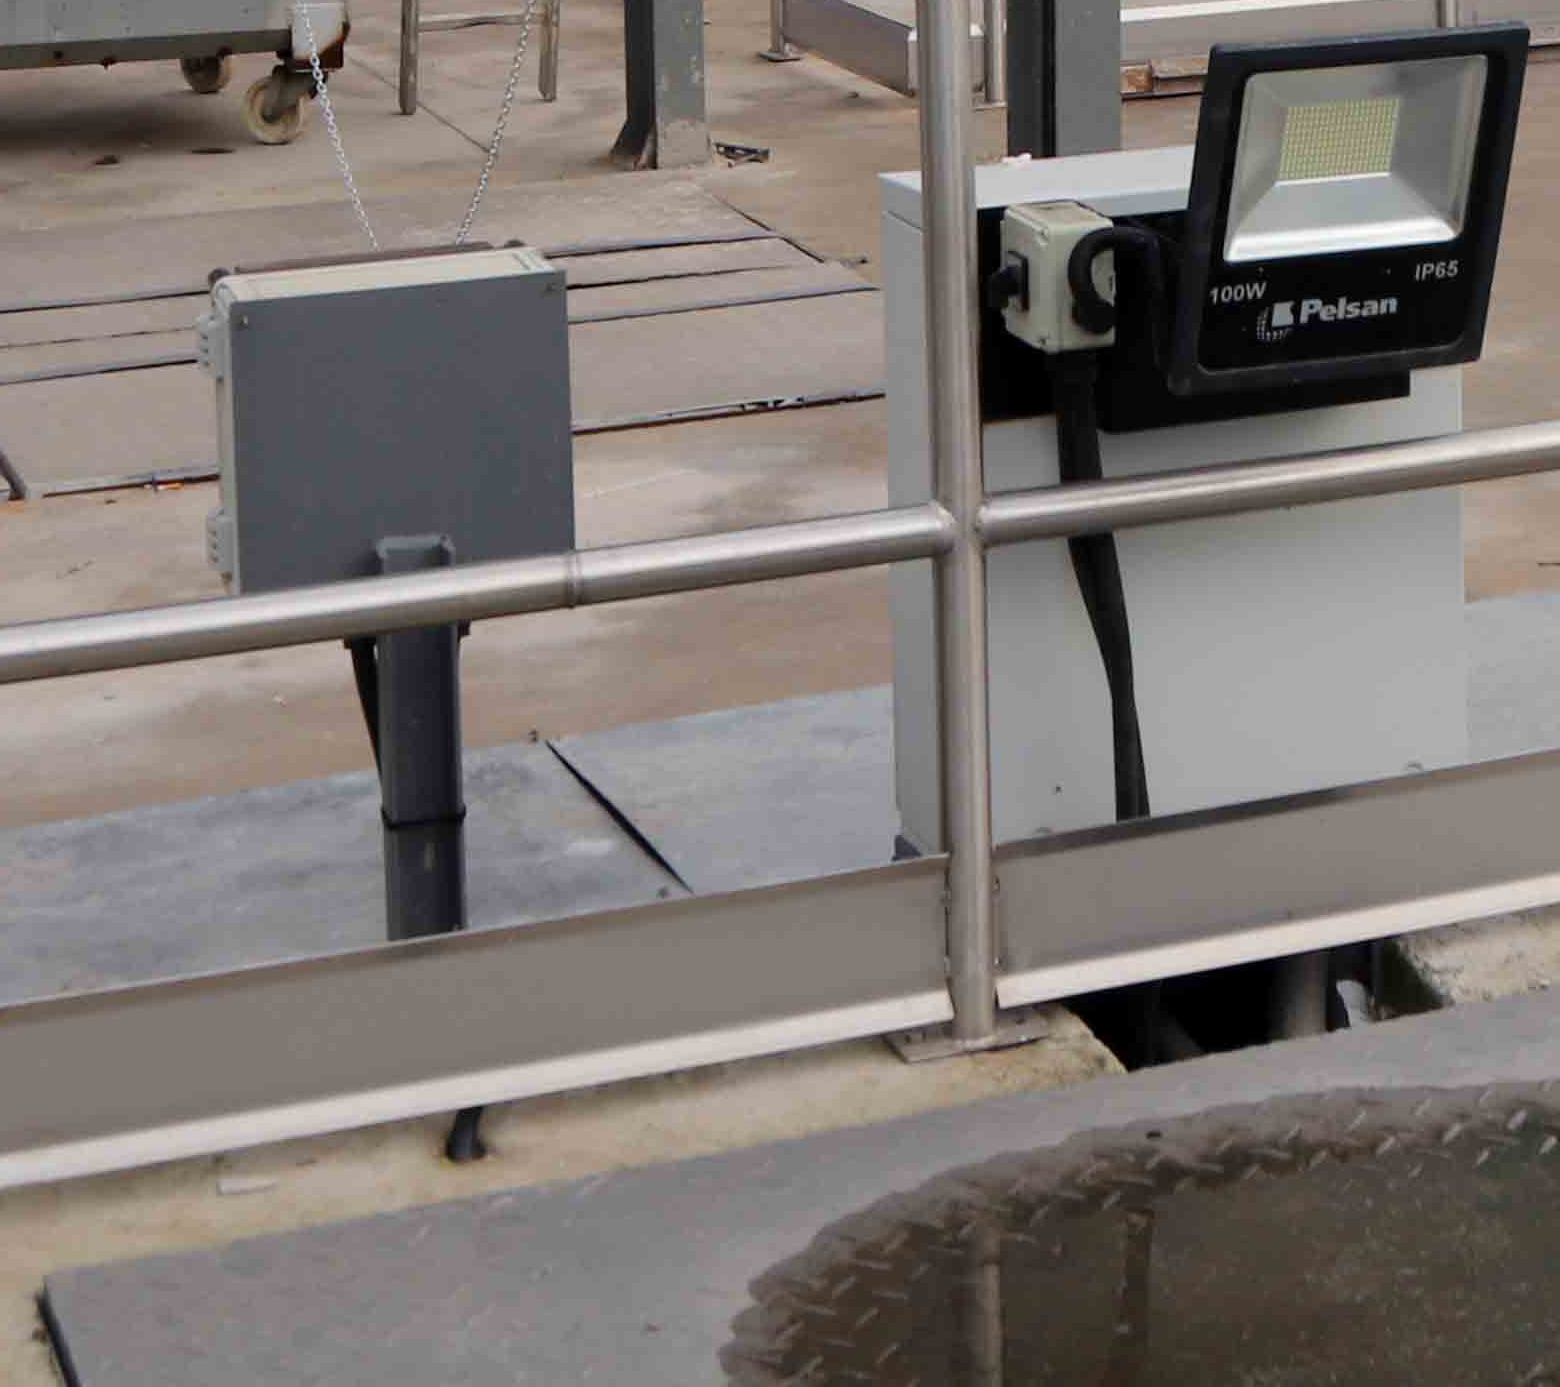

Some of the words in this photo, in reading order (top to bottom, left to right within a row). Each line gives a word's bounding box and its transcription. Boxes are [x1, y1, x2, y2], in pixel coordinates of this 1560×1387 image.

[1415, 259, 1459, 282] IP65
[1209, 281, 1267, 305] 100W
[1299, 296, 1399, 325] Pelsan
